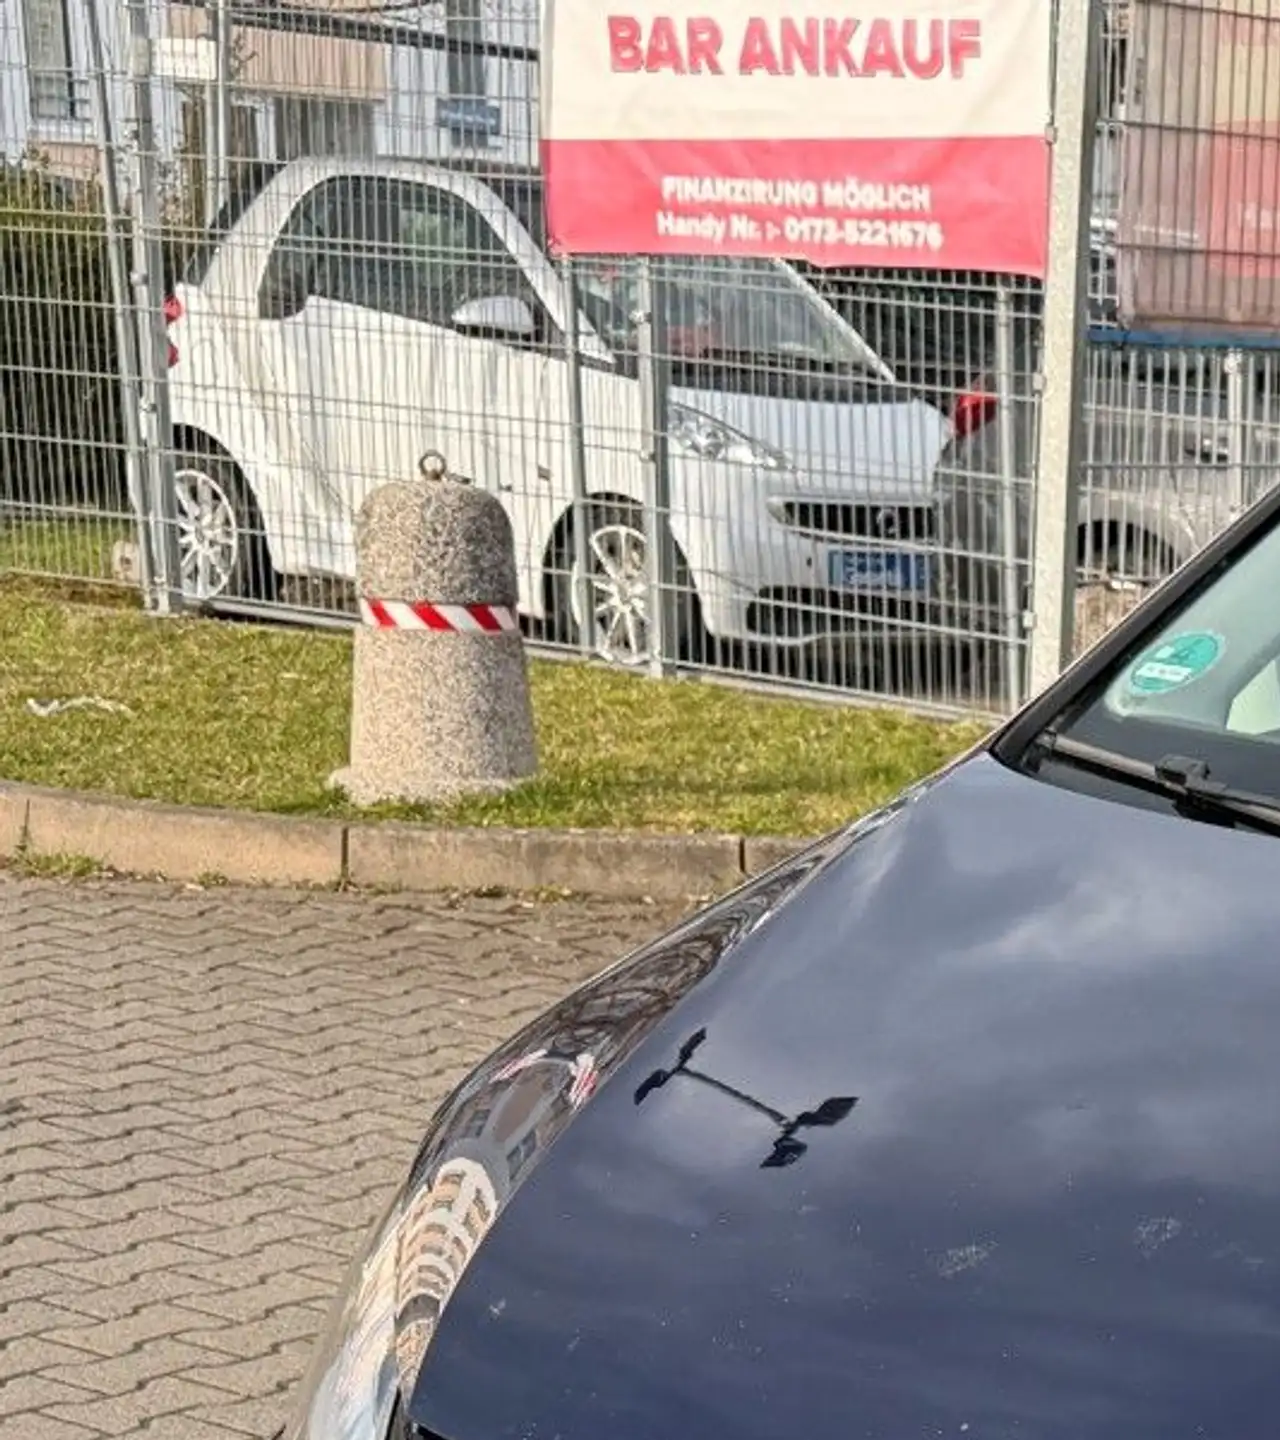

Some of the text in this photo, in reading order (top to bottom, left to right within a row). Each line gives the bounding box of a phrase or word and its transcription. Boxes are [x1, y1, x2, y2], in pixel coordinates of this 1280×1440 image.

[607, 15, 982, 80] BAR ANKAUF
[661, 174, 932, 212] FINANZIRUNG MÖGLICH
[656, 210, 726, 244] Handy
[784, 215, 945, 250] 0173-5221676
